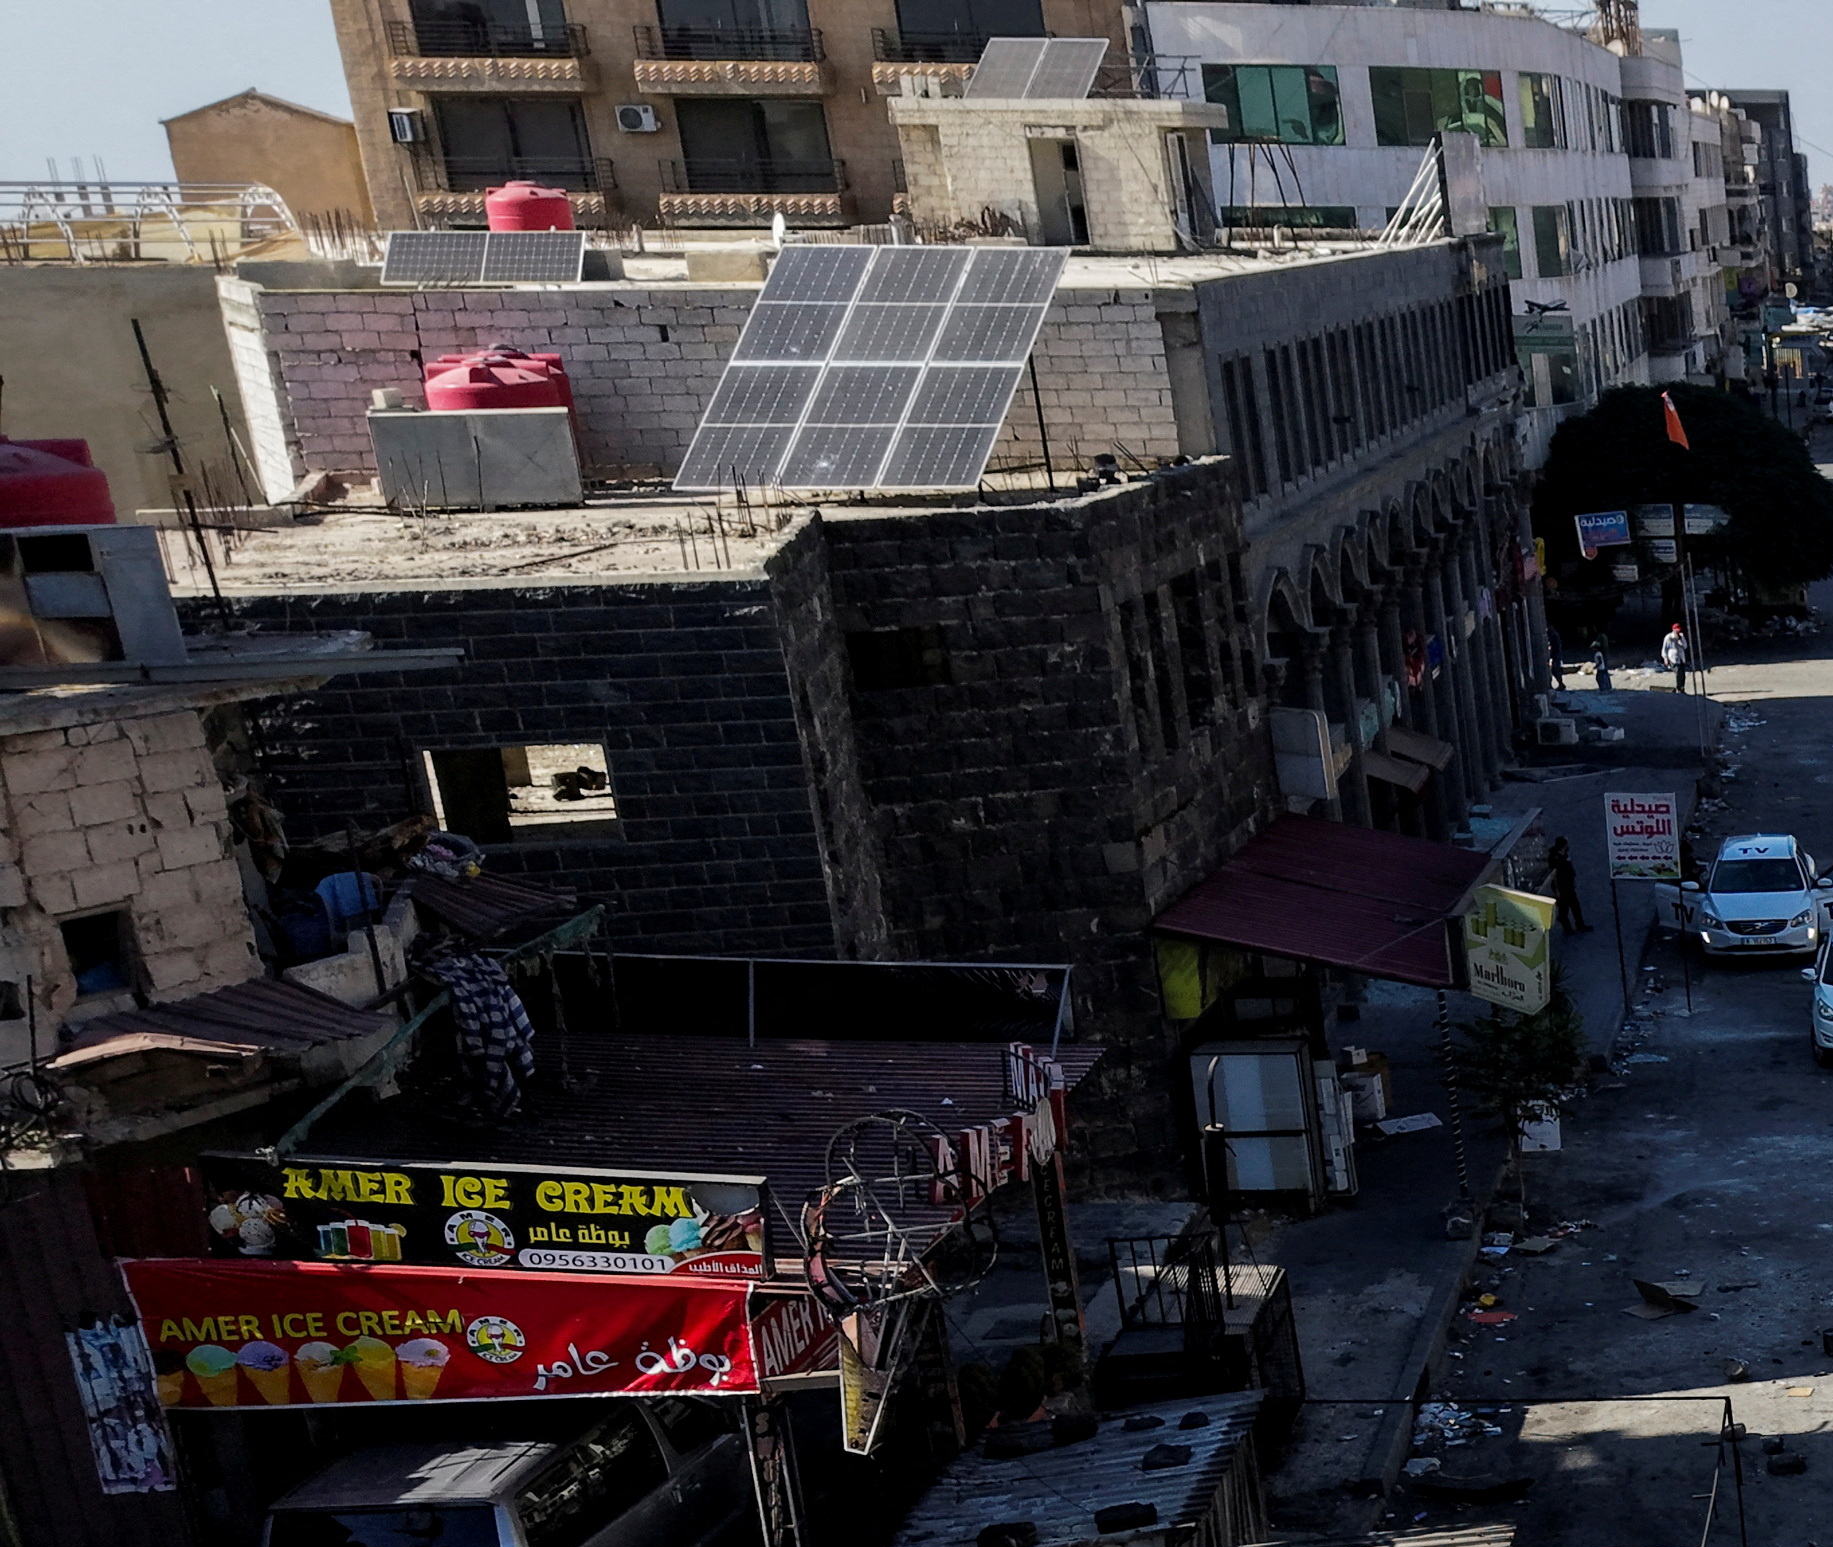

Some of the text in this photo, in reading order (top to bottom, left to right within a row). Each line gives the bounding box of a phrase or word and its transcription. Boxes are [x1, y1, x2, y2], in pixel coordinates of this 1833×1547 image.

[1610, 797, 1671, 819] صيدلية
[1612, 818, 1672, 840] اللوتس
[1738, 847, 1769, 855] TV
[1671, 902, 1695, 924] TV
[282, 1167, 693, 1218] AMER ICE CREAM
[528, 1221, 630, 1248] بوظة عامر
[529, 1252, 666, 1271] 0956330101
[160, 1308, 464, 1342] AMER ICE CREAM
[533, 1335, 732, 1390] بوظة عامر
